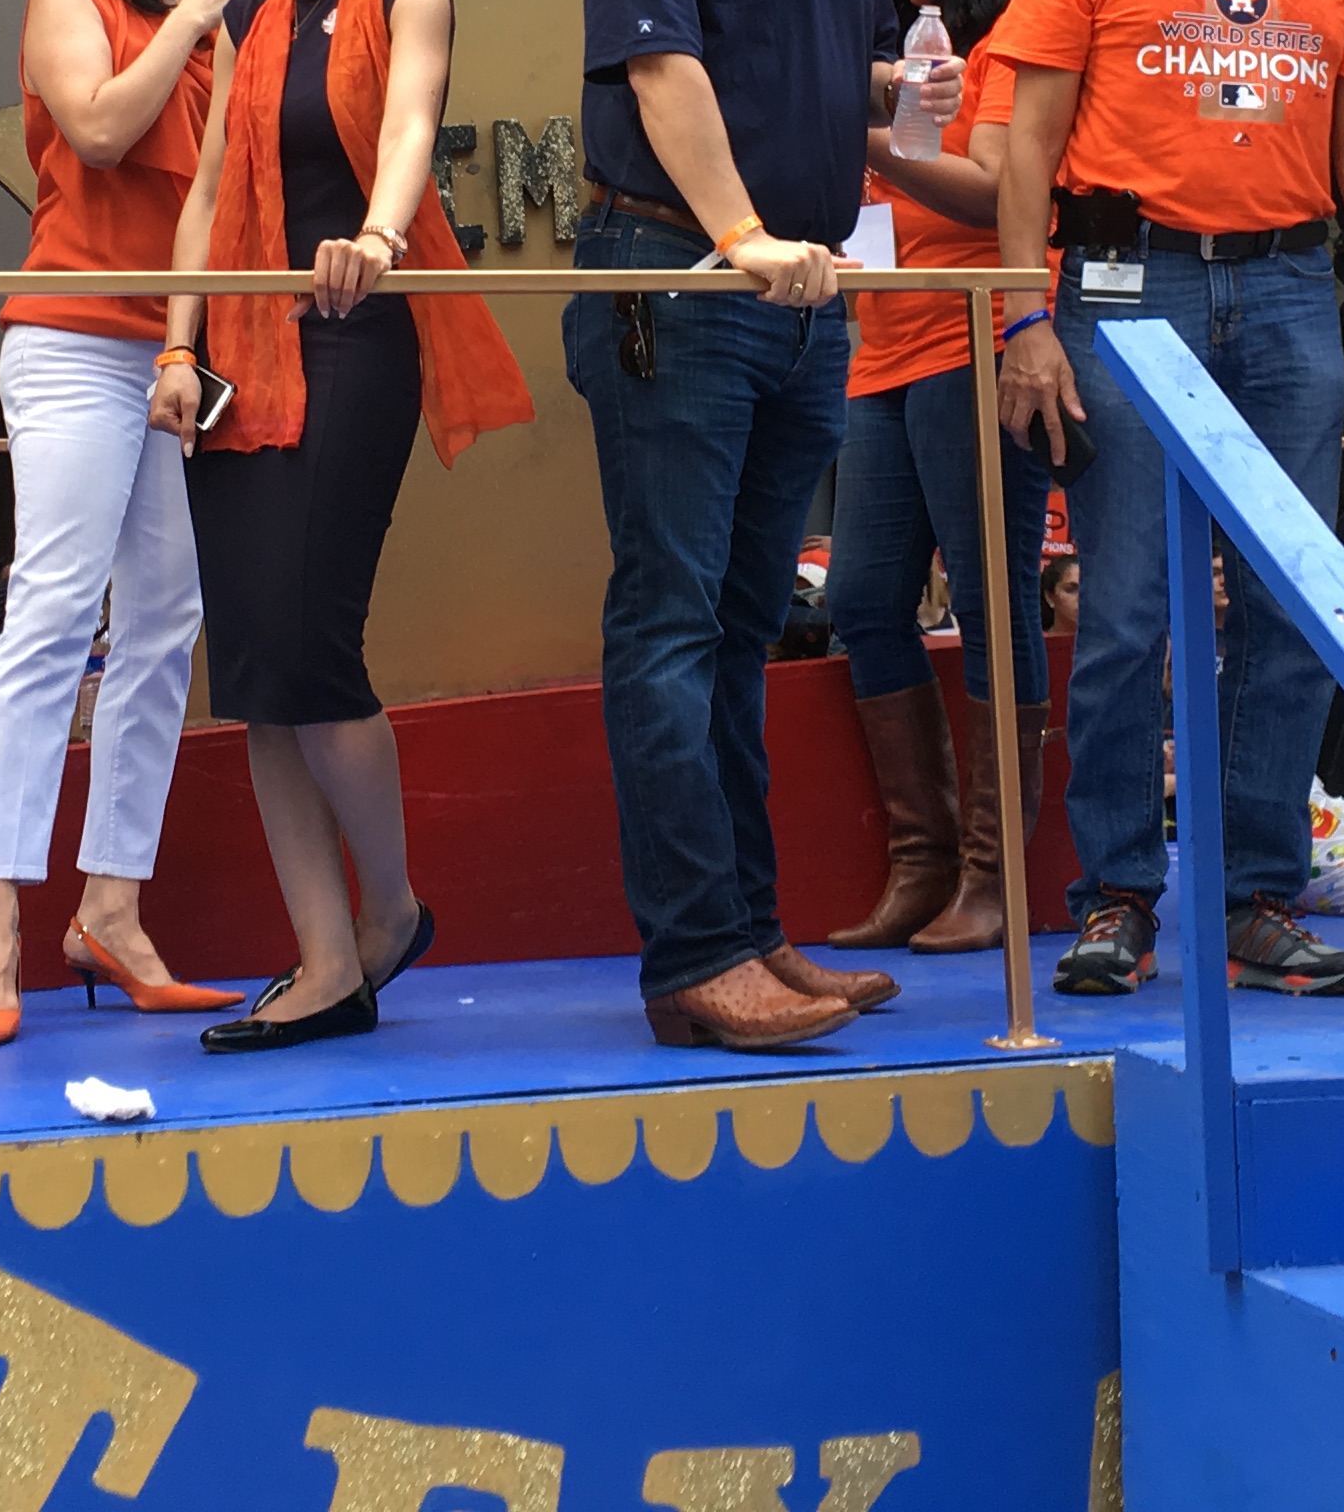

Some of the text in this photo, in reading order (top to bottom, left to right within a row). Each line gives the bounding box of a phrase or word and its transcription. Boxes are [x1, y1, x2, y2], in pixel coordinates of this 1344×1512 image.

[1158, 20, 1323, 56] WORLD SERIES
[1136, 44, 1330, 90] CHAMPIONS
